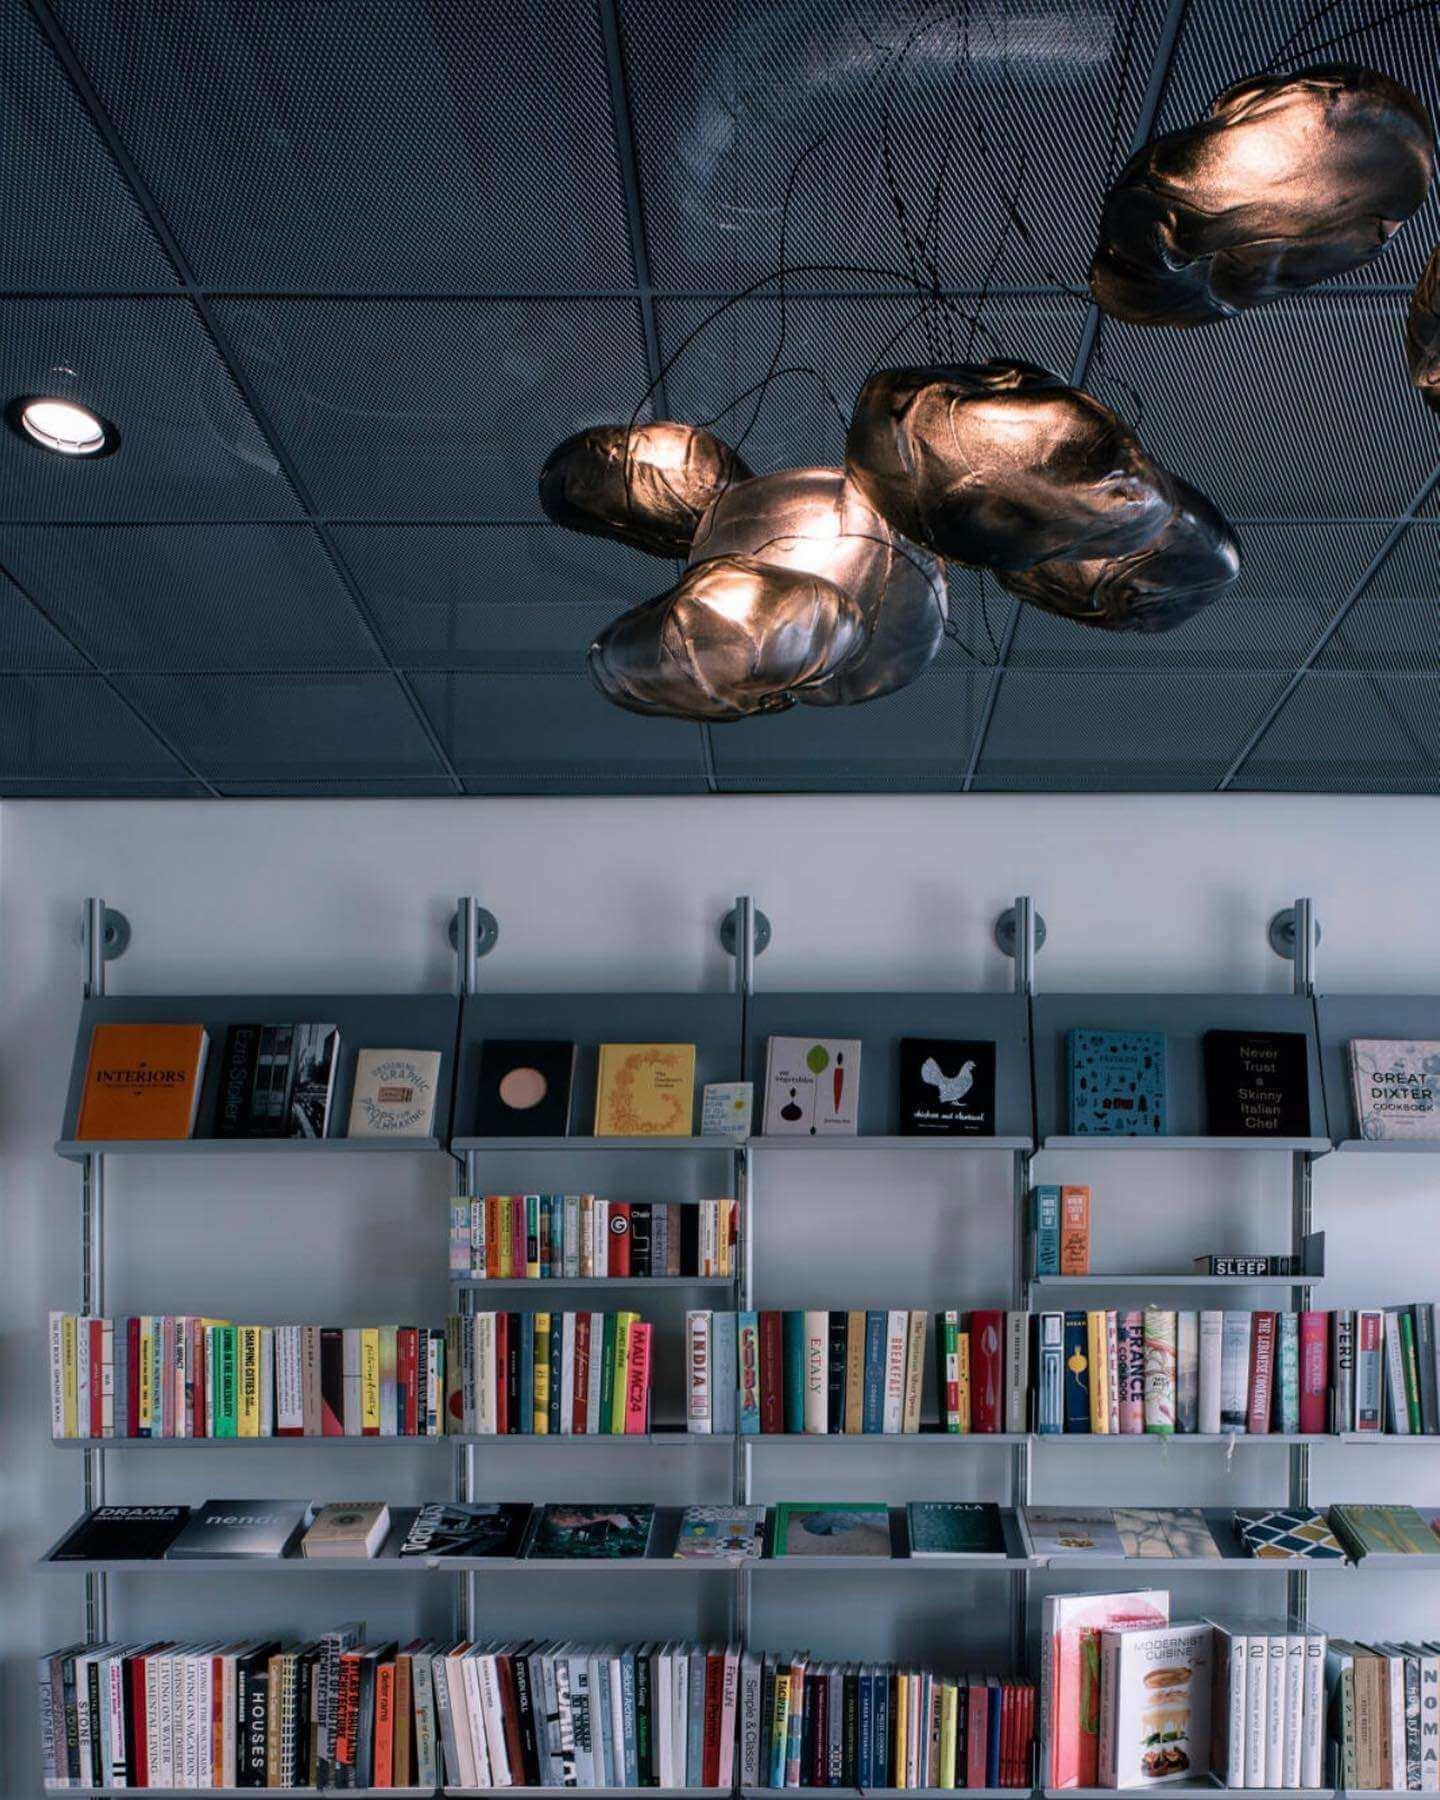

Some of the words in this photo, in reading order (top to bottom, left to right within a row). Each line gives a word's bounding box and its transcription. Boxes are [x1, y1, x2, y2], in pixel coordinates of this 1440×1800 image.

[232, 1030, 252, 1064] Ezra
[1240, 1046, 1279, 1058] Never
[97, 1071, 185, 1082] INTERIORS
[1243, 1061, 1277, 1072] Trust
[1256, 1078, 1264, 1086] a
[1372, 1073, 1427, 1084] GREAT
[224, 1068, 247, 1120] Stoller
[1240, 1088, 1282, 1103] Skinny
[1241, 1103, 1281, 1115] Italian
[1372, 1088, 1432, 1100] DIXTER
[1373, 1103, 1434, 1111] COOKBOOK
[1245, 1116, 1278, 1129] Chef
[1216, 1263, 1266, 1275] SLEEP
[1258, 1318, 1270, 1333] THE
[245, 1329, 255, 1366] SHAPING
[632, 1331, 645, 1366] MAU
[693, 1331, 707, 1387] INDIA
[1256, 1335, 1269, 1373] LEBANESE
[1339, 1323, 1352, 1369] PERU
[552, 1331, 560, 1410] AALTO
[810, 1338, 821, 1394] EATALY
[889, 1338, 903, 1399] BREAKFAST
[1118, 1346, 1127, 1404] COOKBOOK
[1130, 1326, 1144, 1402] FRANCE
[1312, 1343, 1322, 1395] MEXICO
[245, 1368, 255, 1395] CITIES
[630, 1370, 642, 1412] MC24
[1254, 1374, 1267, 1414] COOKBOOK
[96, 1508, 178, 1516] DRAMA
[329, 1640, 340, 1676] ATLAS
[1136, 1635, 1204, 1650] MODERNIST
[1146, 1646, 1193, 1660] CUISINE
[1234, 1645, 1243, 1658] 1
[1250, 1645, 1264, 1658] 2
[1270, 1645, 1284, 1658] 3
[1288, 1644, 1302, 1658] 4
[1307, 1645, 1321, 1657] 5
[161, 1662, 171, 1702] LIVING
[174, 1662, 183, 1697] LIVING
[187, 1664, 196, 1702] LIVING
[318, 1640, 330, 1729] ARCHITECTURE
[329, 1679, 339, 1694] OF
[349, 1660, 360, 1694] ATLAS
[380, 1670, 390, 1697] dieter
[516, 1661, 526, 1692] STEVEN
[623, 1664, 633, 1696] Selldorf
[726, 1666, 735, 1686] Finn
[148, 1662, 158, 1728] ELEMENTAL
[175, 1700, 183, 1711] IN
[200, 1692, 207, 1703] IN
[337, 1660, 350, 1739] ARCHITECTURE
[349, 1695, 359, 1708] OF
[380, 1698, 389, 1722] rams
[519, 1692, 529, 1713] HOLL
[725, 1687, 734, 1708] Juhl
[744, 1680, 756, 1718] Simple
[78, 1701, 89, 1748] STONE
[163, 1705, 171, 1722] ON
[175, 1714, 184, 1732] THE
[187, 1704, 196, 1720] ON
[327, 1697, 339, 1760] BRUTALIST
[623, 1697, 633, 1740] Architects
[745, 1720, 755, 1729] &
[1424, 1671, 1438, 1761] NOMA
[163, 1725, 172, 1764] WATER
[251, 1693, 265, 1768] HOUSES
[346, 1710, 359, 1763] BRUTALIS
[150, 1734, 159, 1774] LIVING
[175, 1737, 184, 1775] DESERT
[186, 1722, 196, 1776] VACATION
[200, 1724, 208, 1776] MOUNTAINS
[745, 1731, 756, 1773] Classic
